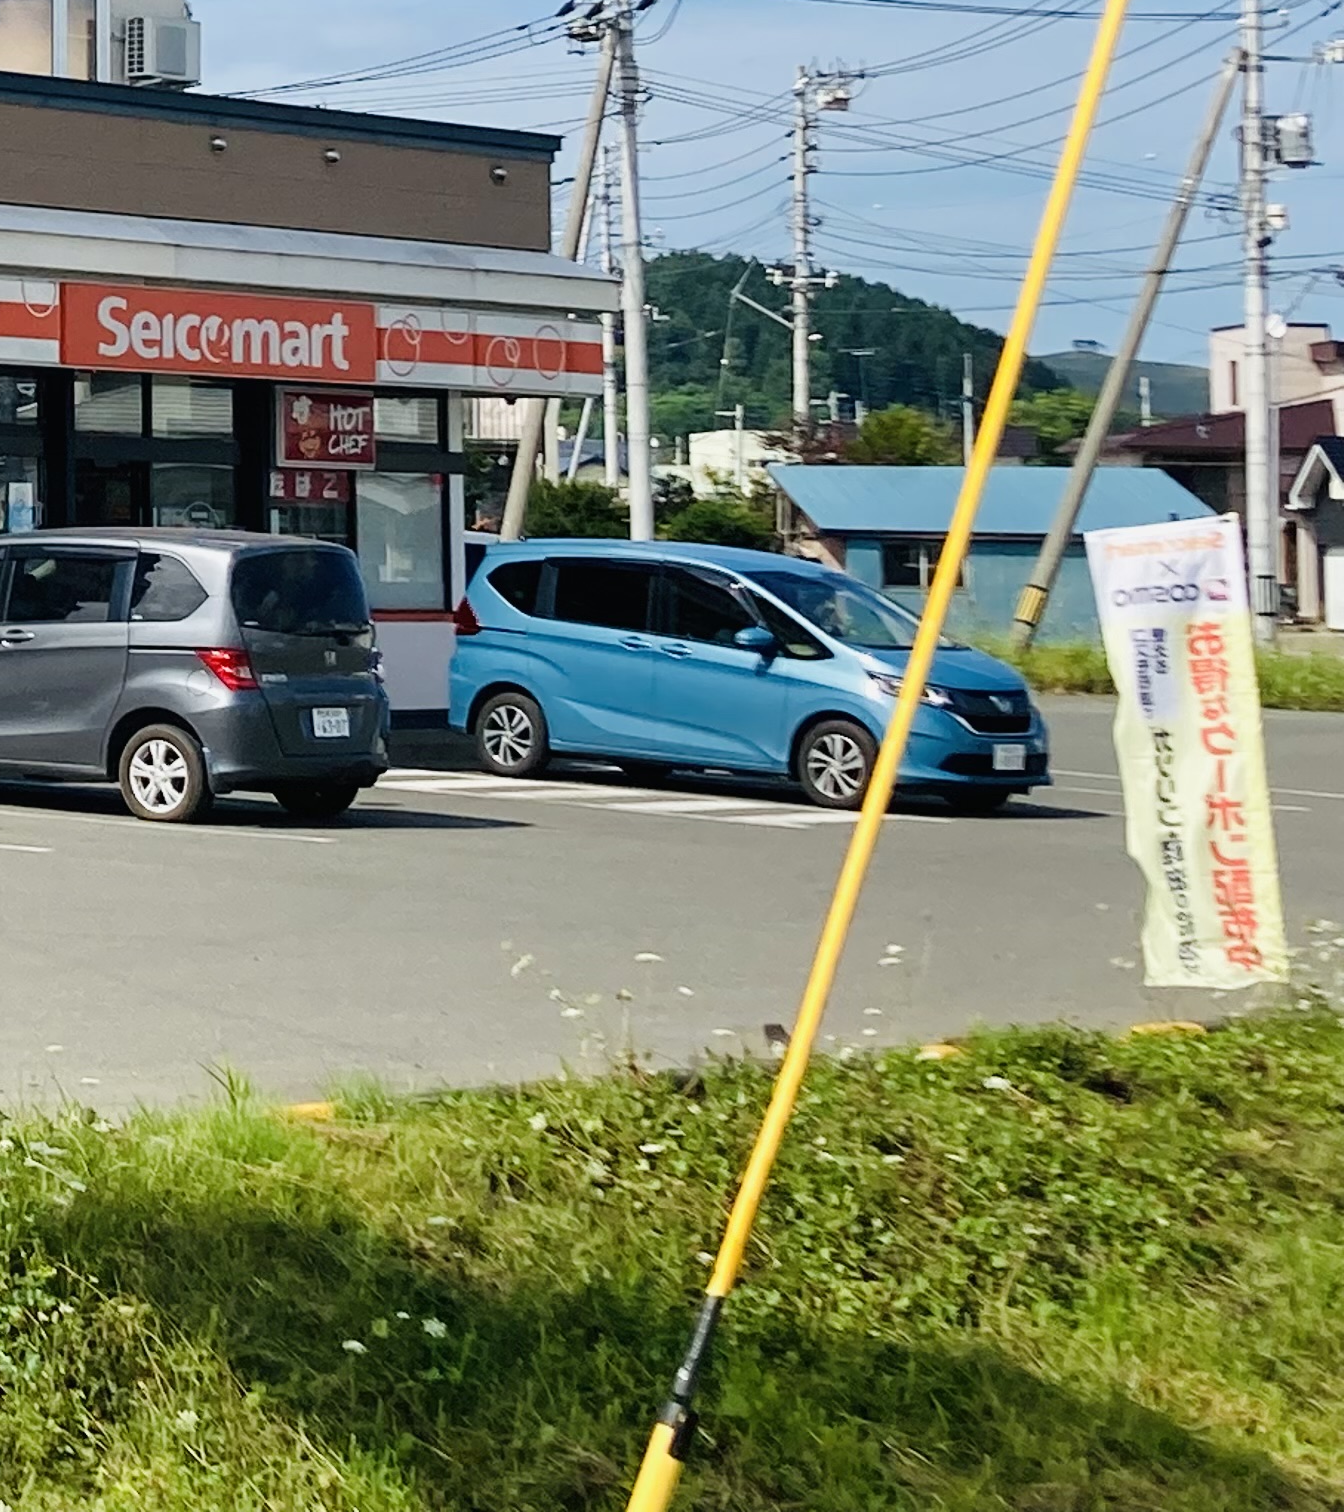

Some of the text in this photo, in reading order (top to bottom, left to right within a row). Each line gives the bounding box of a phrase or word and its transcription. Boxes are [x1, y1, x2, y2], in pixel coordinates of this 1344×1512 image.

[97, 296, 350, 371] Seicomart
[329, 403, 371, 431] HOT
[328, 434, 369, 455] CHEF
